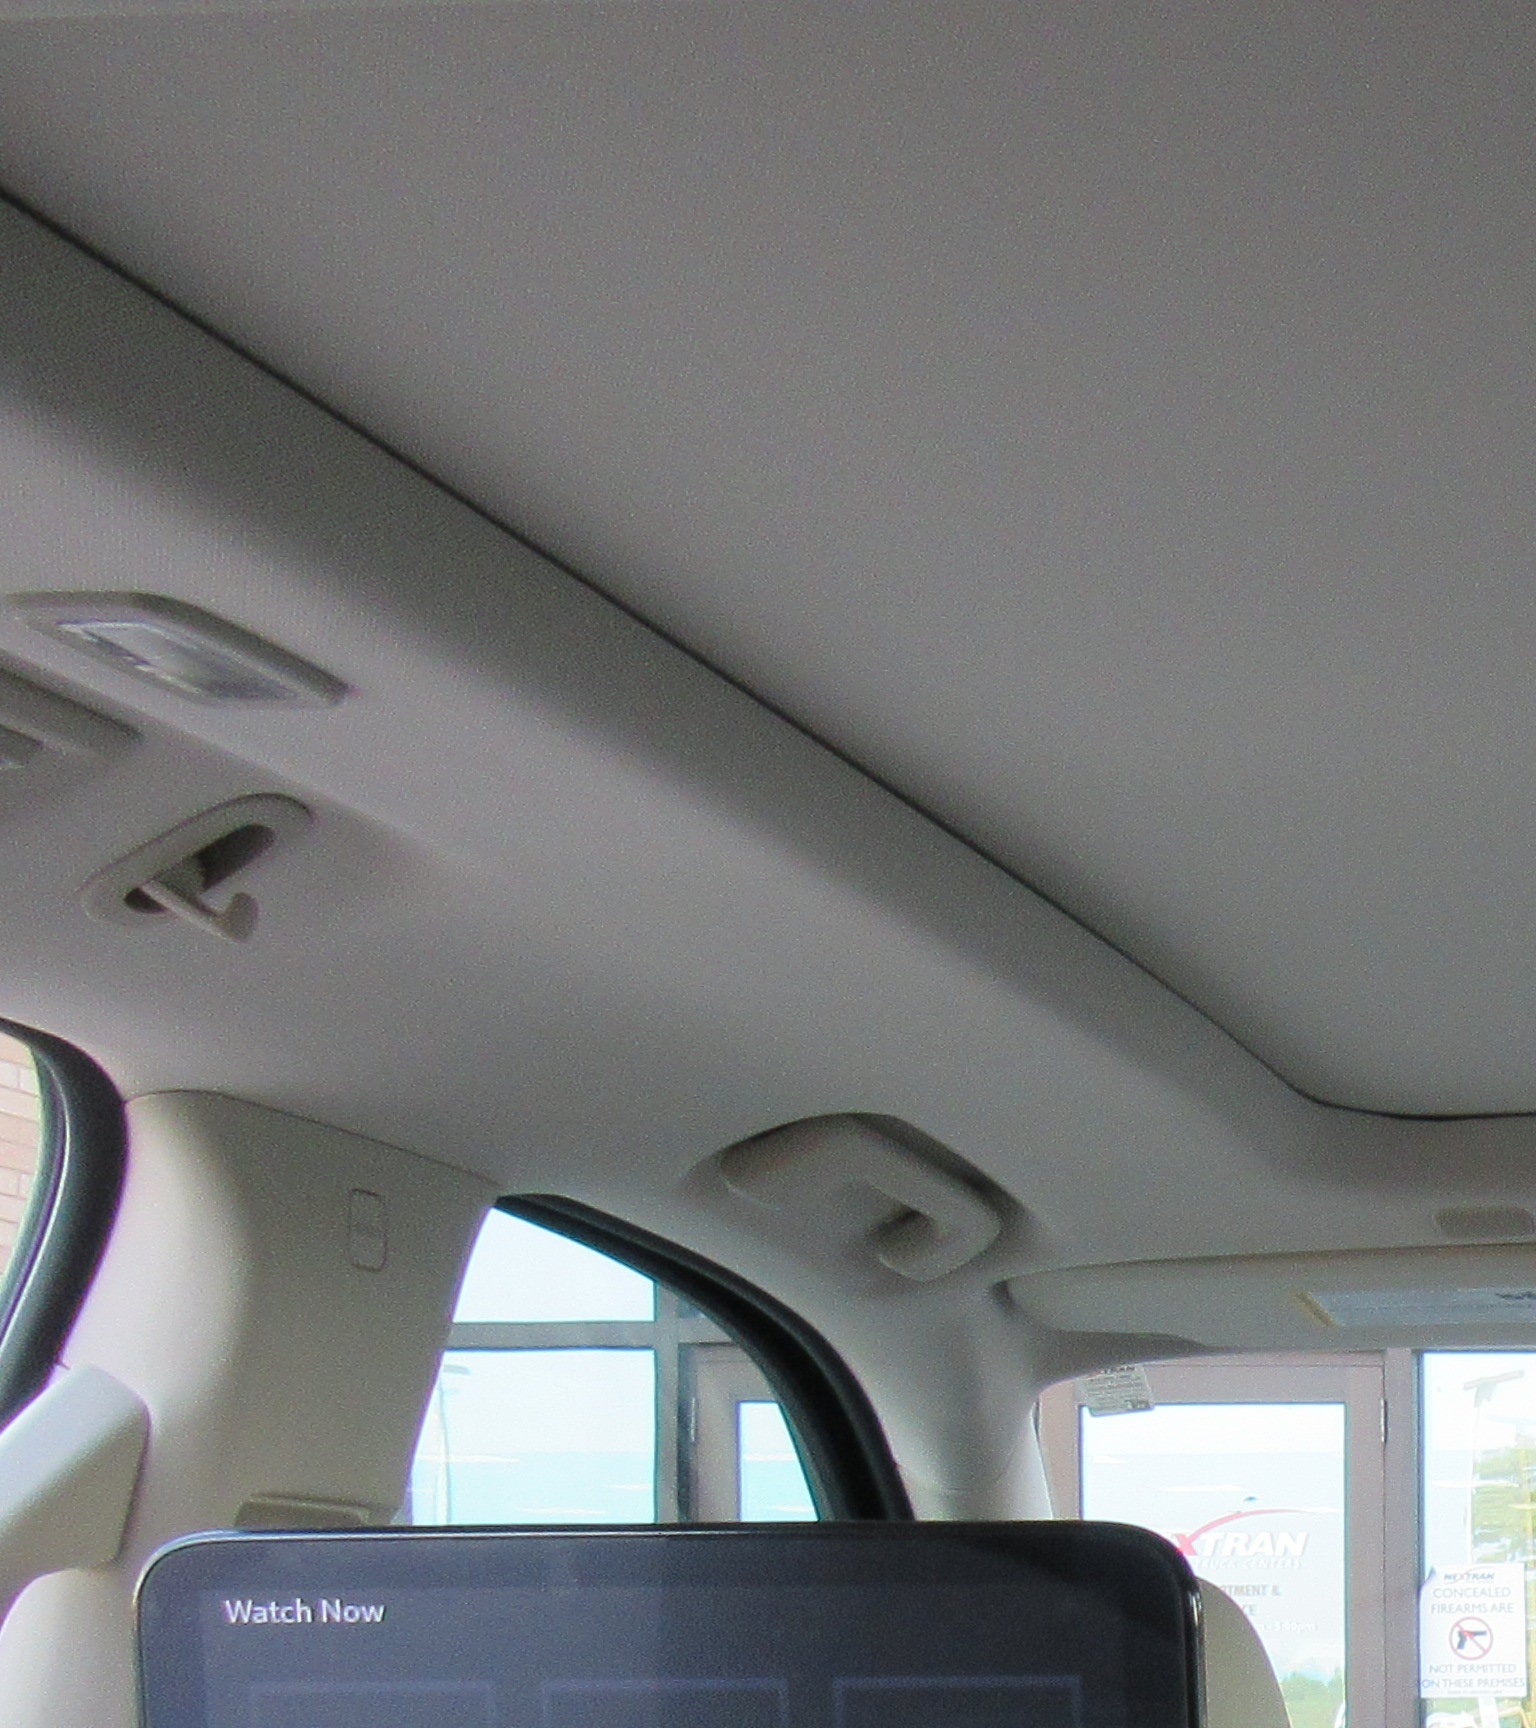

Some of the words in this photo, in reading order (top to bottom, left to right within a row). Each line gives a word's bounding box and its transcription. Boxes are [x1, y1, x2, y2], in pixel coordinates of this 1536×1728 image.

[1174, 1531, 1310, 1557] XTRAN
[1433, 1587, 1511, 1599] CONCEALED
[224, 1599, 313, 1625] Watch
[321, 1600, 385, 1625] Now
[1431, 1603, 1488, 1614] FIREARMS
[1492, 1603, 1515, 1613] ARE
[1429, 1664, 1454, 1674] NOT
[1457, 1663, 1517, 1674] PERMITTED
[1421, 1679, 1439, 1689] ON
[1443, 1679, 1474, 1688] THESE
